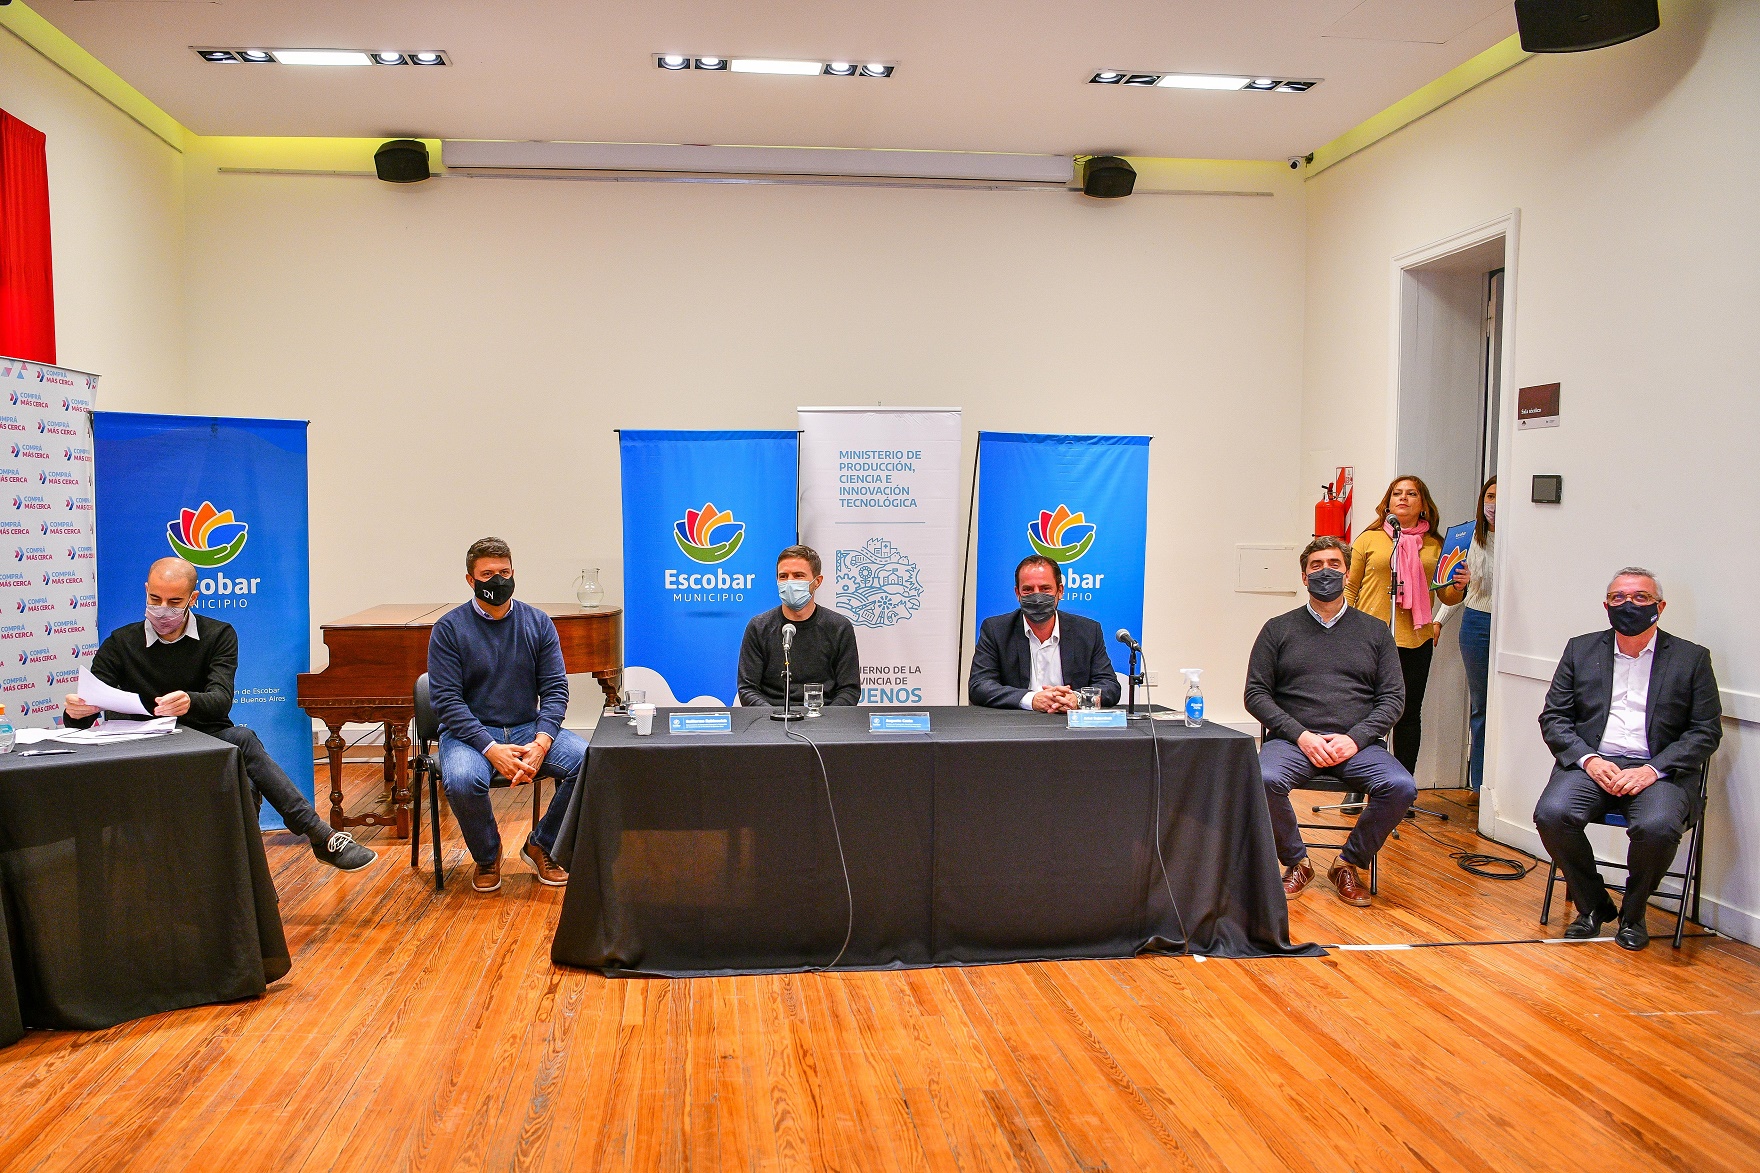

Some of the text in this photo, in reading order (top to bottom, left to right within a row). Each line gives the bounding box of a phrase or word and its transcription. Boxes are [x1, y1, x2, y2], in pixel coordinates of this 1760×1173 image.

[839, 450, 922, 460] MINISTERIO DE
[839, 460, 916, 473] PRODUCCIÓN,
[839, 474, 893, 484] CIENCIA E
[839, 484, 910, 496] INNOVACIÓN
[839, 496, 918, 508] TECNOLÓGICA
[196, 571, 261, 595] obar
[664, 567, 756, 590] Escobar
[673, 593, 744, 602] MUNICIPIO
[191, 598, 248, 609] NICIPIO
[859, 665, 922, 675] IERNO DE LA
[894, 676, 908, 685] DE
[16, 682, 36, 690] CERCA
[252, 687, 280, 695] Escobar
[240, 696, 267, 704] Buenos
